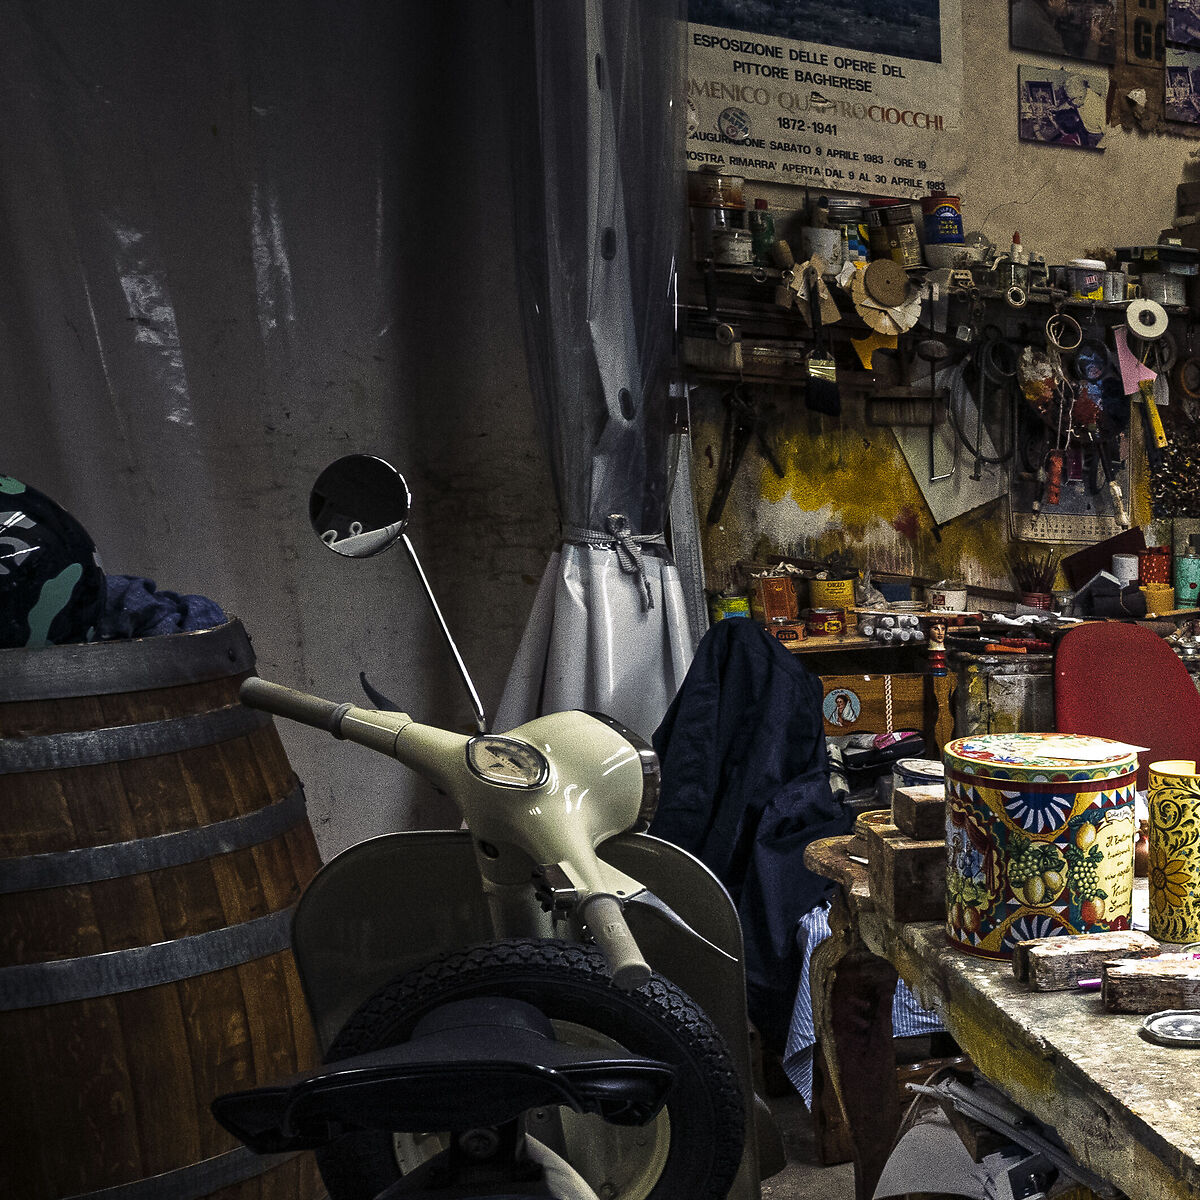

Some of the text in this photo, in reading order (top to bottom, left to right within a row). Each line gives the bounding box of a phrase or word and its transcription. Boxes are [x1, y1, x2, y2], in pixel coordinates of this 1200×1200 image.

[693, 33, 906, 79] ESPOSIZIONE DELLE OPERE DEL
[686, 78, 770, 106] MENICO
[733, 60, 873, 93] PITTORE BAGHERESE
[777, 117, 838, 136] 1872-1941
[769, 141, 812, 155] SABATO
[815, 147, 823, 156] 9
[826, 148, 860, 161] APRILE
[863, 153, 884, 165] 1983
[893, 157, 914, 169] ORE
[917, 160, 927, 170] 19
[729, 156, 778, 170] RIMARRA'
[782, 163, 821, 177] APERTA
[824, 168, 845, 179] DAL
[848, 171, 856, 180] 9
[858, 172, 872, 183] AL
[875, 174, 888, 185] 30
[890, 176, 923, 188] APRILE
[926, 180, 947, 191] 1983
